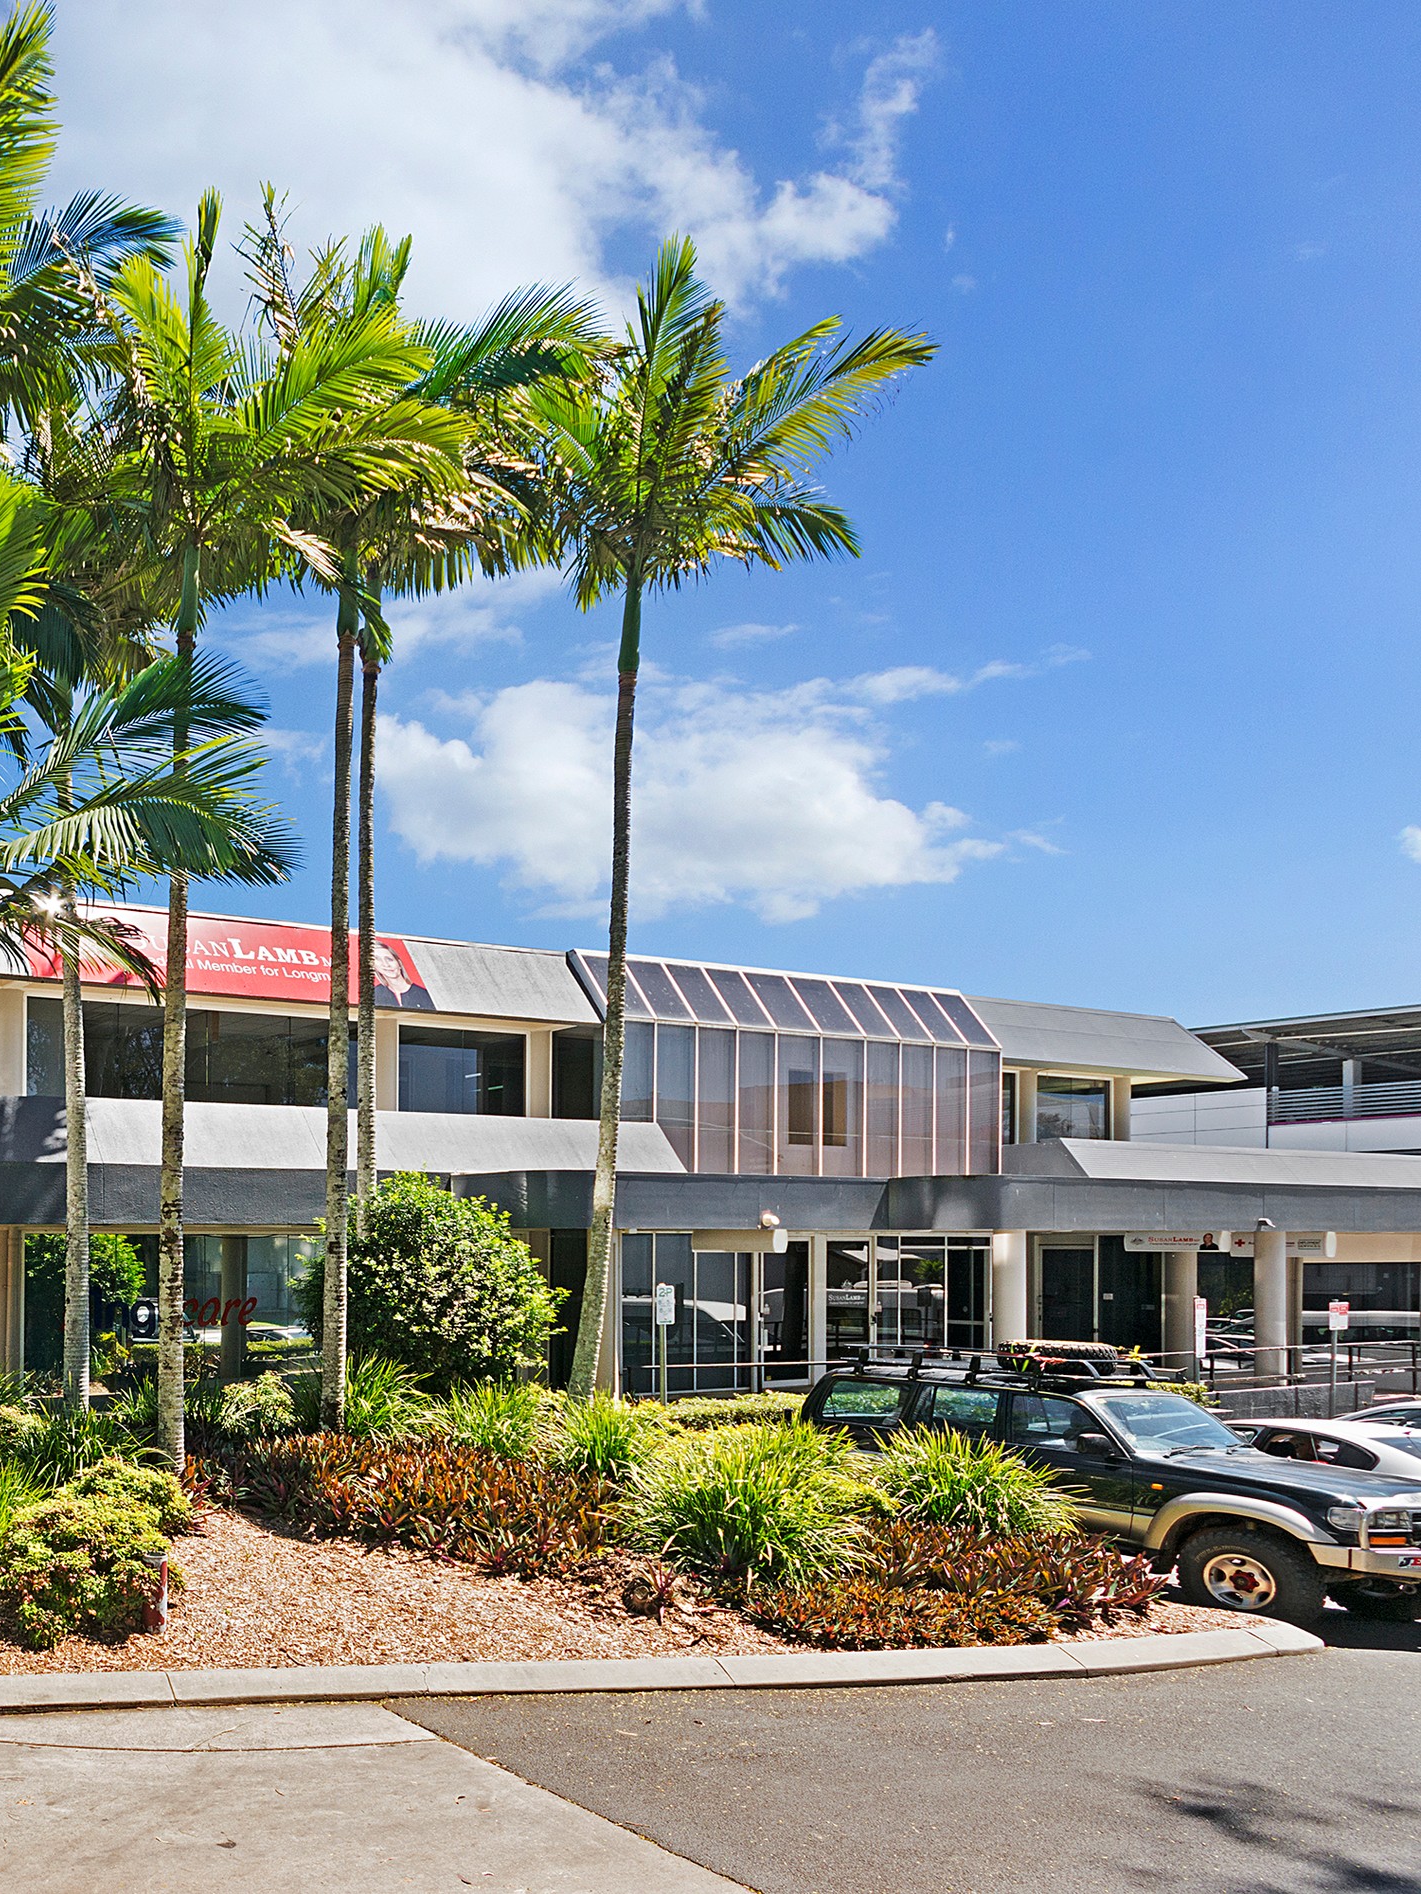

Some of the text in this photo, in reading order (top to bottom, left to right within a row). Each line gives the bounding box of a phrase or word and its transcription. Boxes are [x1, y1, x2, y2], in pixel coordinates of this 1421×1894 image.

[197, 959, 257, 974] Member
[260, 964, 279, 977] for
[658, 1287, 673, 1298] 2P
